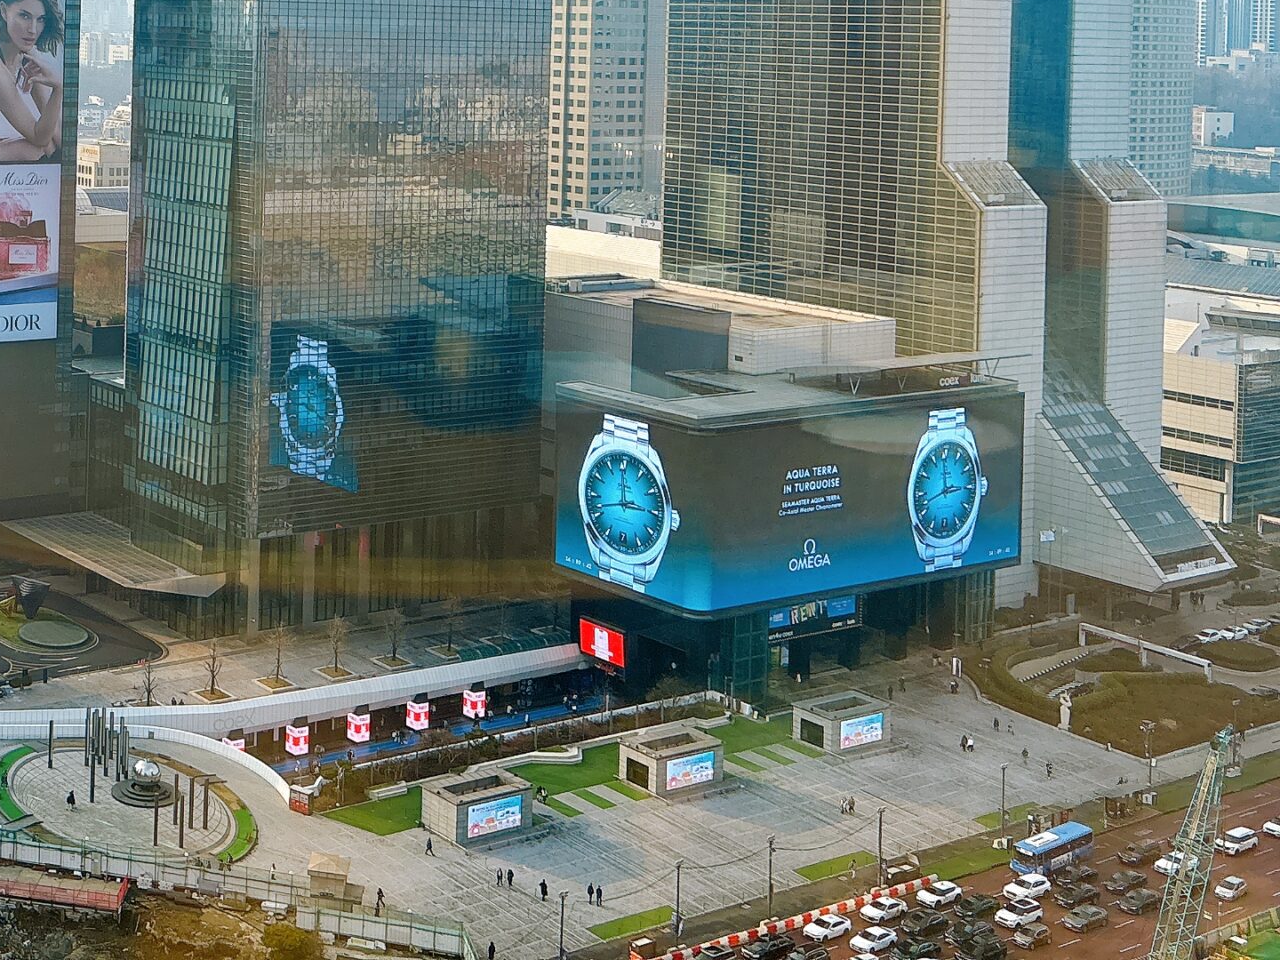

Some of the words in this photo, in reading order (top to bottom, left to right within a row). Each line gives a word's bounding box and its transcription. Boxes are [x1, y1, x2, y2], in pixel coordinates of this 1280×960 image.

[25, 171, 49, 186] Dior
[939, 376, 960, 387] coex
[785, 468, 811, 480] AQUA
[812, 465, 838, 476] TERRA
[783, 484, 792, 494] IN
[794, 478, 840, 492] TURQUOISE
[788, 554, 831, 572] OMEGA
[213, 708, 256, 731] coex
